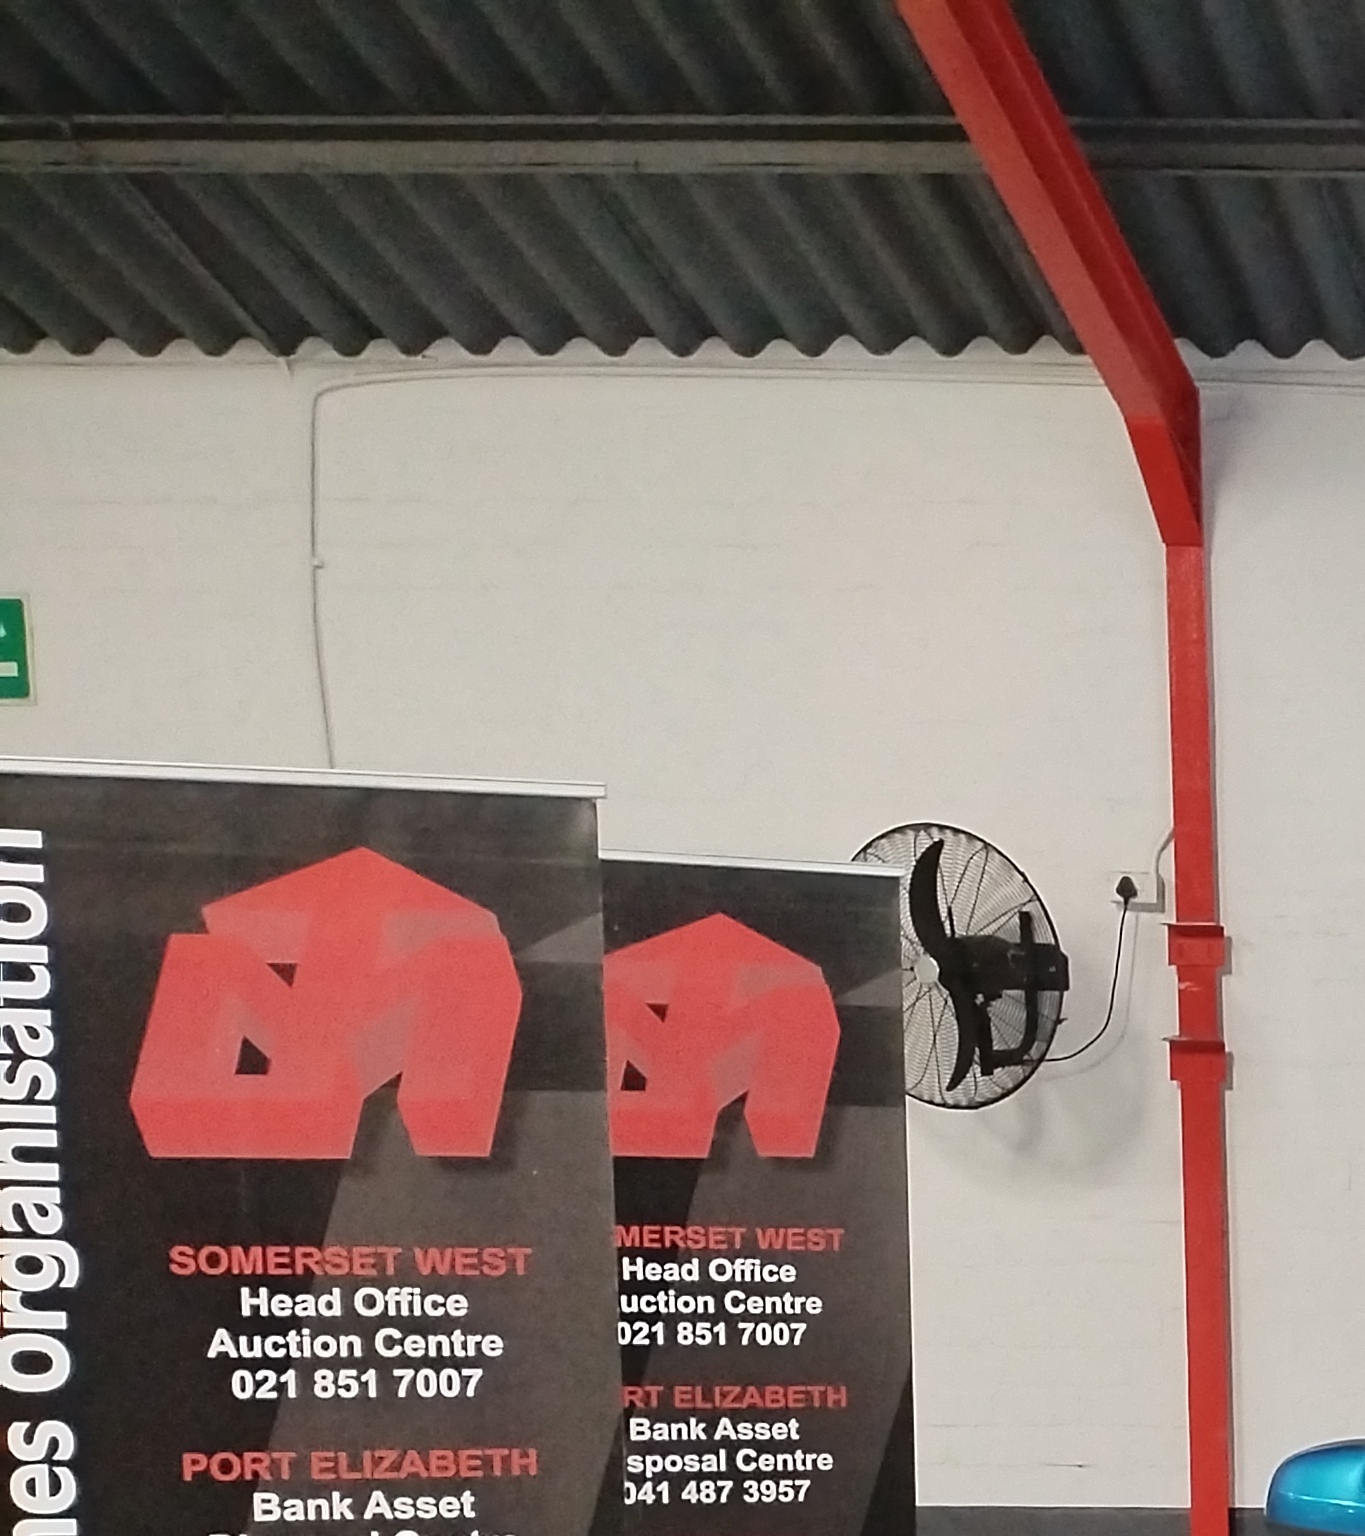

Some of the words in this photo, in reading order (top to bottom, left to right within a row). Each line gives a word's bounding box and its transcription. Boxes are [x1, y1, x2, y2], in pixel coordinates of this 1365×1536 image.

[615, 1225, 743, 1250] MERSET
[756, 1228, 841, 1251] WEST
[170, 1245, 398, 1275] SOMERSET
[416, 1248, 528, 1276] WEST
[623, 1257, 699, 1281] Head
[709, 1258, 796, 1282] Office
[241, 1287, 341, 1316] Head
[354, 1287, 468, 1316] Office
[621, 1290, 715, 1313] uction
[725, 1290, 822, 1314] Centre
[207, 1328, 362, 1358] Auction
[375, 1328, 503, 1357] Centre
[677, 1322, 725, 1345] 851
[738, 1323, 806, 1345] 7007
[232, 1369, 296, 1399] 021
[314, 1369, 376, 1398] 851
[393, 1369, 483, 1397] 7007
[620, 1385, 662, 1407] RT
[674, 1385, 847, 1408] ELIZABETH
[630, 1418, 706, 1441] Bank
[714, 1417, 799, 1440] Asset
[182, 1451, 293, 1481] PORT
[310, 1448, 538, 1481] ELIZABETH
[627, 1449, 726, 1478] sposal
[736, 1449, 833, 1471] Centre
[682, 1481, 733, 1503] 487
[744, 1480, 810, 1502] 3957
[253, 1491, 354, 1521] Bank
[364, 1491, 475, 1519] Asset
